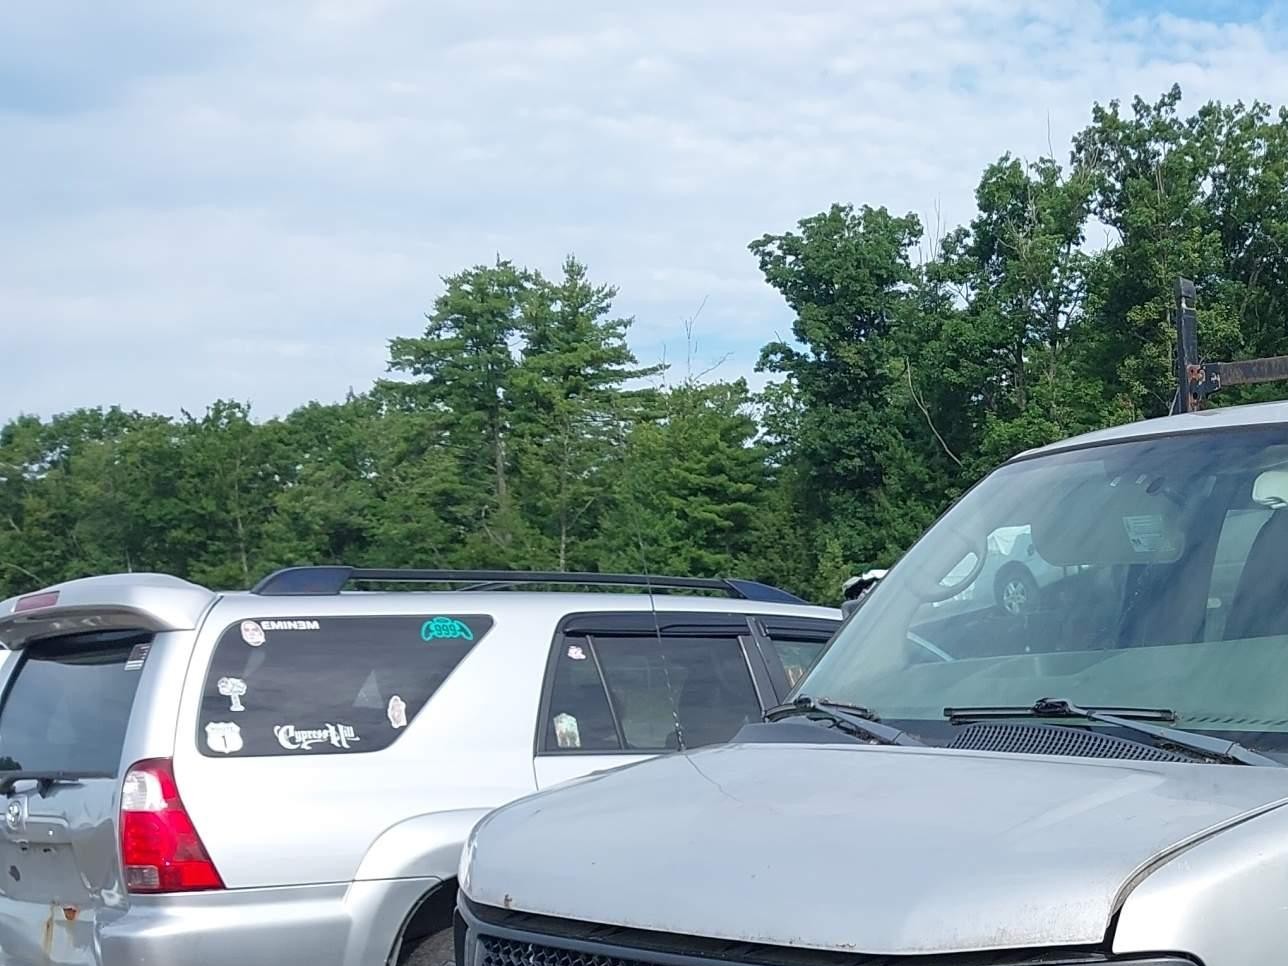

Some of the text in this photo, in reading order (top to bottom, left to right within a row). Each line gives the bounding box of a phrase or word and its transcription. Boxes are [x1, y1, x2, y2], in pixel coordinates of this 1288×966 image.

[260, 620, 320, 630] EMINEM
[434, 624, 457, 636] 999
[273, 723, 360, 750] Cypress Hill
